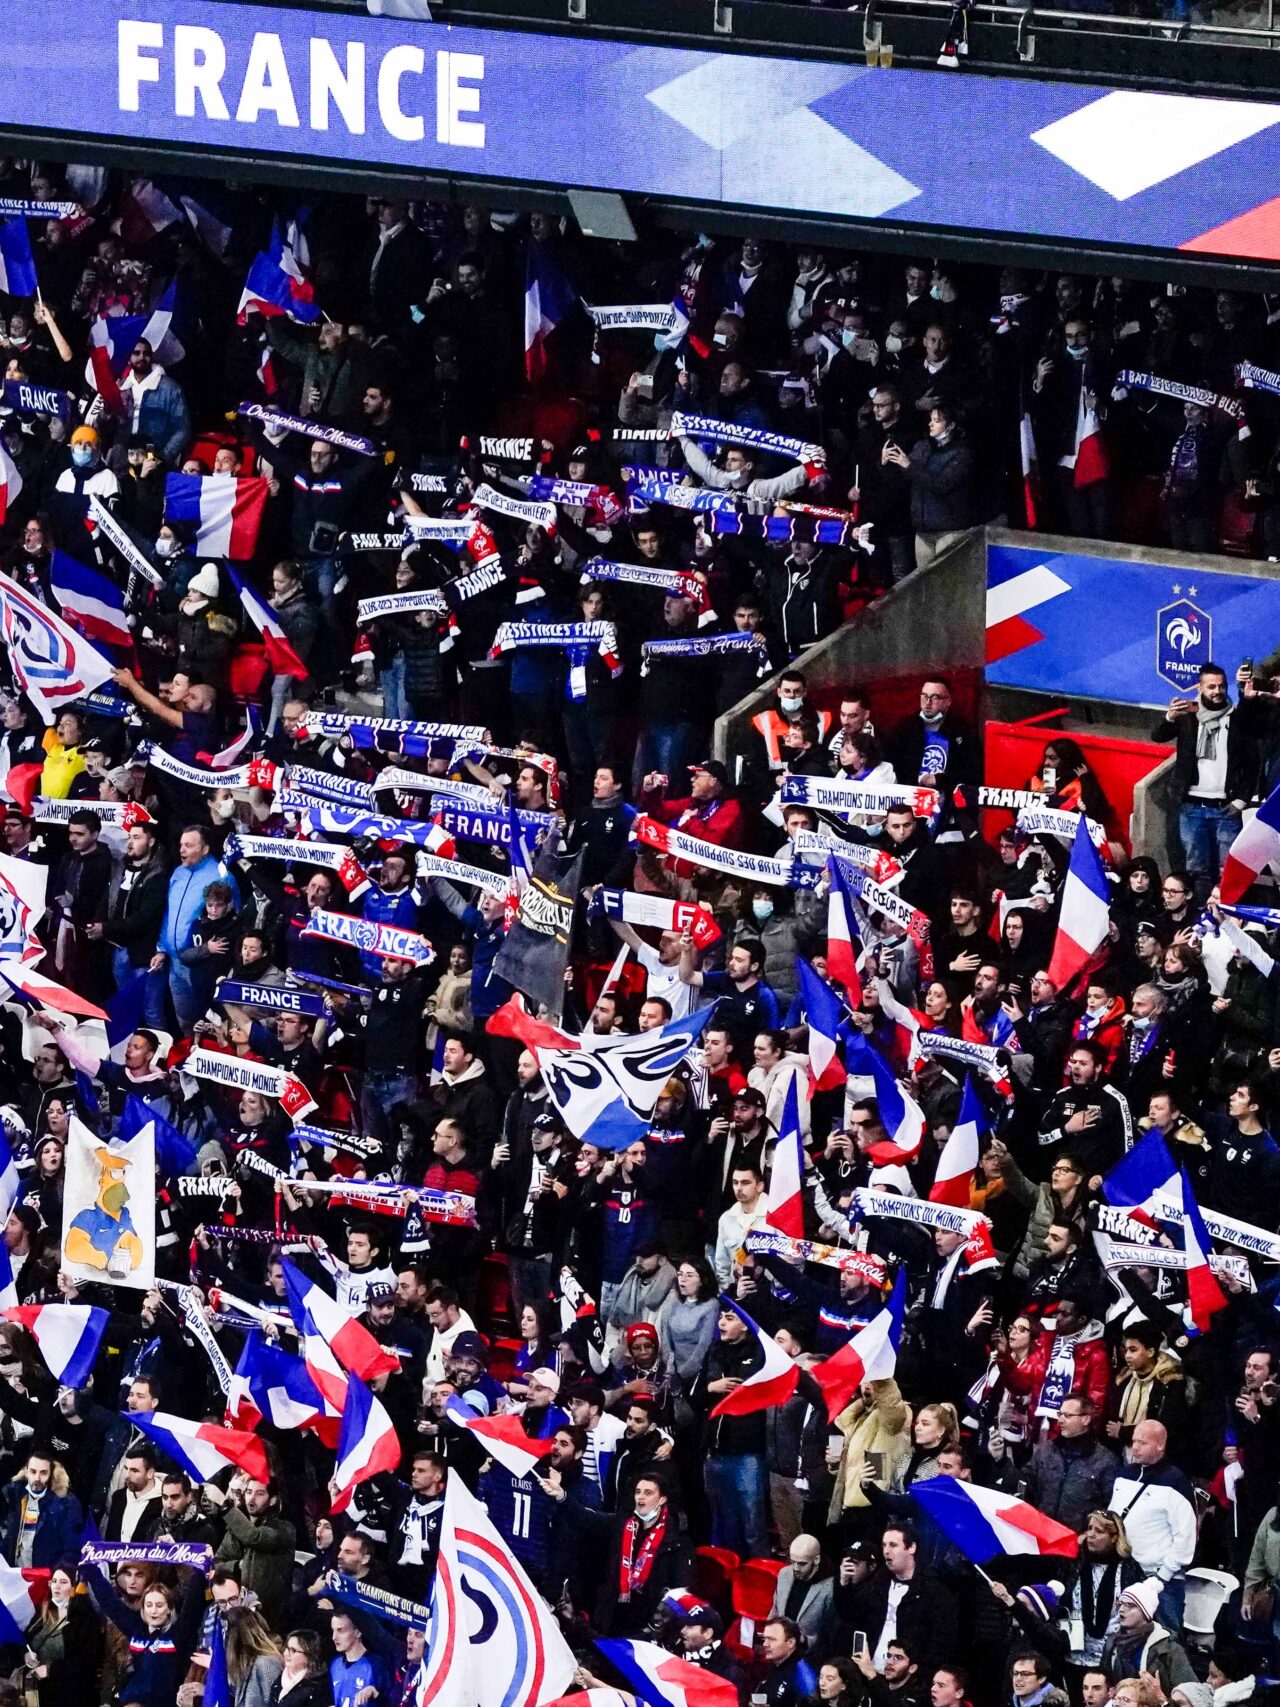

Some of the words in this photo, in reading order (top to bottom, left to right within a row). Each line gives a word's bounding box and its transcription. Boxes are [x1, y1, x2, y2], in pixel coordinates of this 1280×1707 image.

[118, 20, 485, 148] FRANCE
[20, 386, 58, 413] FRANCE
[246, 404, 307, 432] Champions
[308, 421, 323, 437] du
[323, 427, 365, 450] Monde
[480, 437, 534, 461] FRANCE
[351, 533, 381, 549] PAUL
[455, 560, 506, 600] FRANCE
[816, 789, 862, 809] CHAMPIONS
[865, 793, 875, 809] DU
[978, 786, 1050, 808] FRANCE
[445, 813, 512, 842] FRANC
[252, 842, 295, 857] CHAMPIONS
[297, 846, 307, 859] DU
[309, 850, 336, 865] MONDE
[677, 836, 735, 867] SUPPORTERS
[798, 834, 816, 850] CLUB
[831, 838, 871, 863] SUPPORTERS
[737, 858, 756, 871] DES
[758, 861, 781, 875] CLUB
[603, 890, 620, 914] F
[678, 905, 696, 929] F
[848, 868, 862, 888] BAT
[863, 880, 872, 896] LE
[873, 888, 896, 915] CŒUR
[898, 905, 913, 926] DES
[317, 915, 416, 956] FRANCE
[242, 987, 301, 1010] FRANCE
[196, 1057, 239, 1085] CHAMPIONS
[240, 1070, 251, 1087] DU
[252, 1075, 279, 1094] MONDE
[178, 1176, 233, 1197] FRANC
[618, 1207, 631, 1224] 10
[871, 1198, 920, 1222] CHAMPIONS
[922, 1205, 934, 1223] DU
[936, 1209, 967, 1233] MONDE
[1098, 1205, 1158, 1245] FRANCE
[1239, 1232, 1274, 1254] MONDE
[349, 1287, 360, 1305] 14
[372, 1284, 391, 1297] FFF
[511, 1477, 532, 1491] CLAUSS
[512, 1491, 531, 1539] 11
[148, 1545, 167, 1559] du
[356, 1581, 399, 1607] CHAMPIONS
[400, 1599, 412, 1612] DU
[413, 1602, 430, 1618] MON
